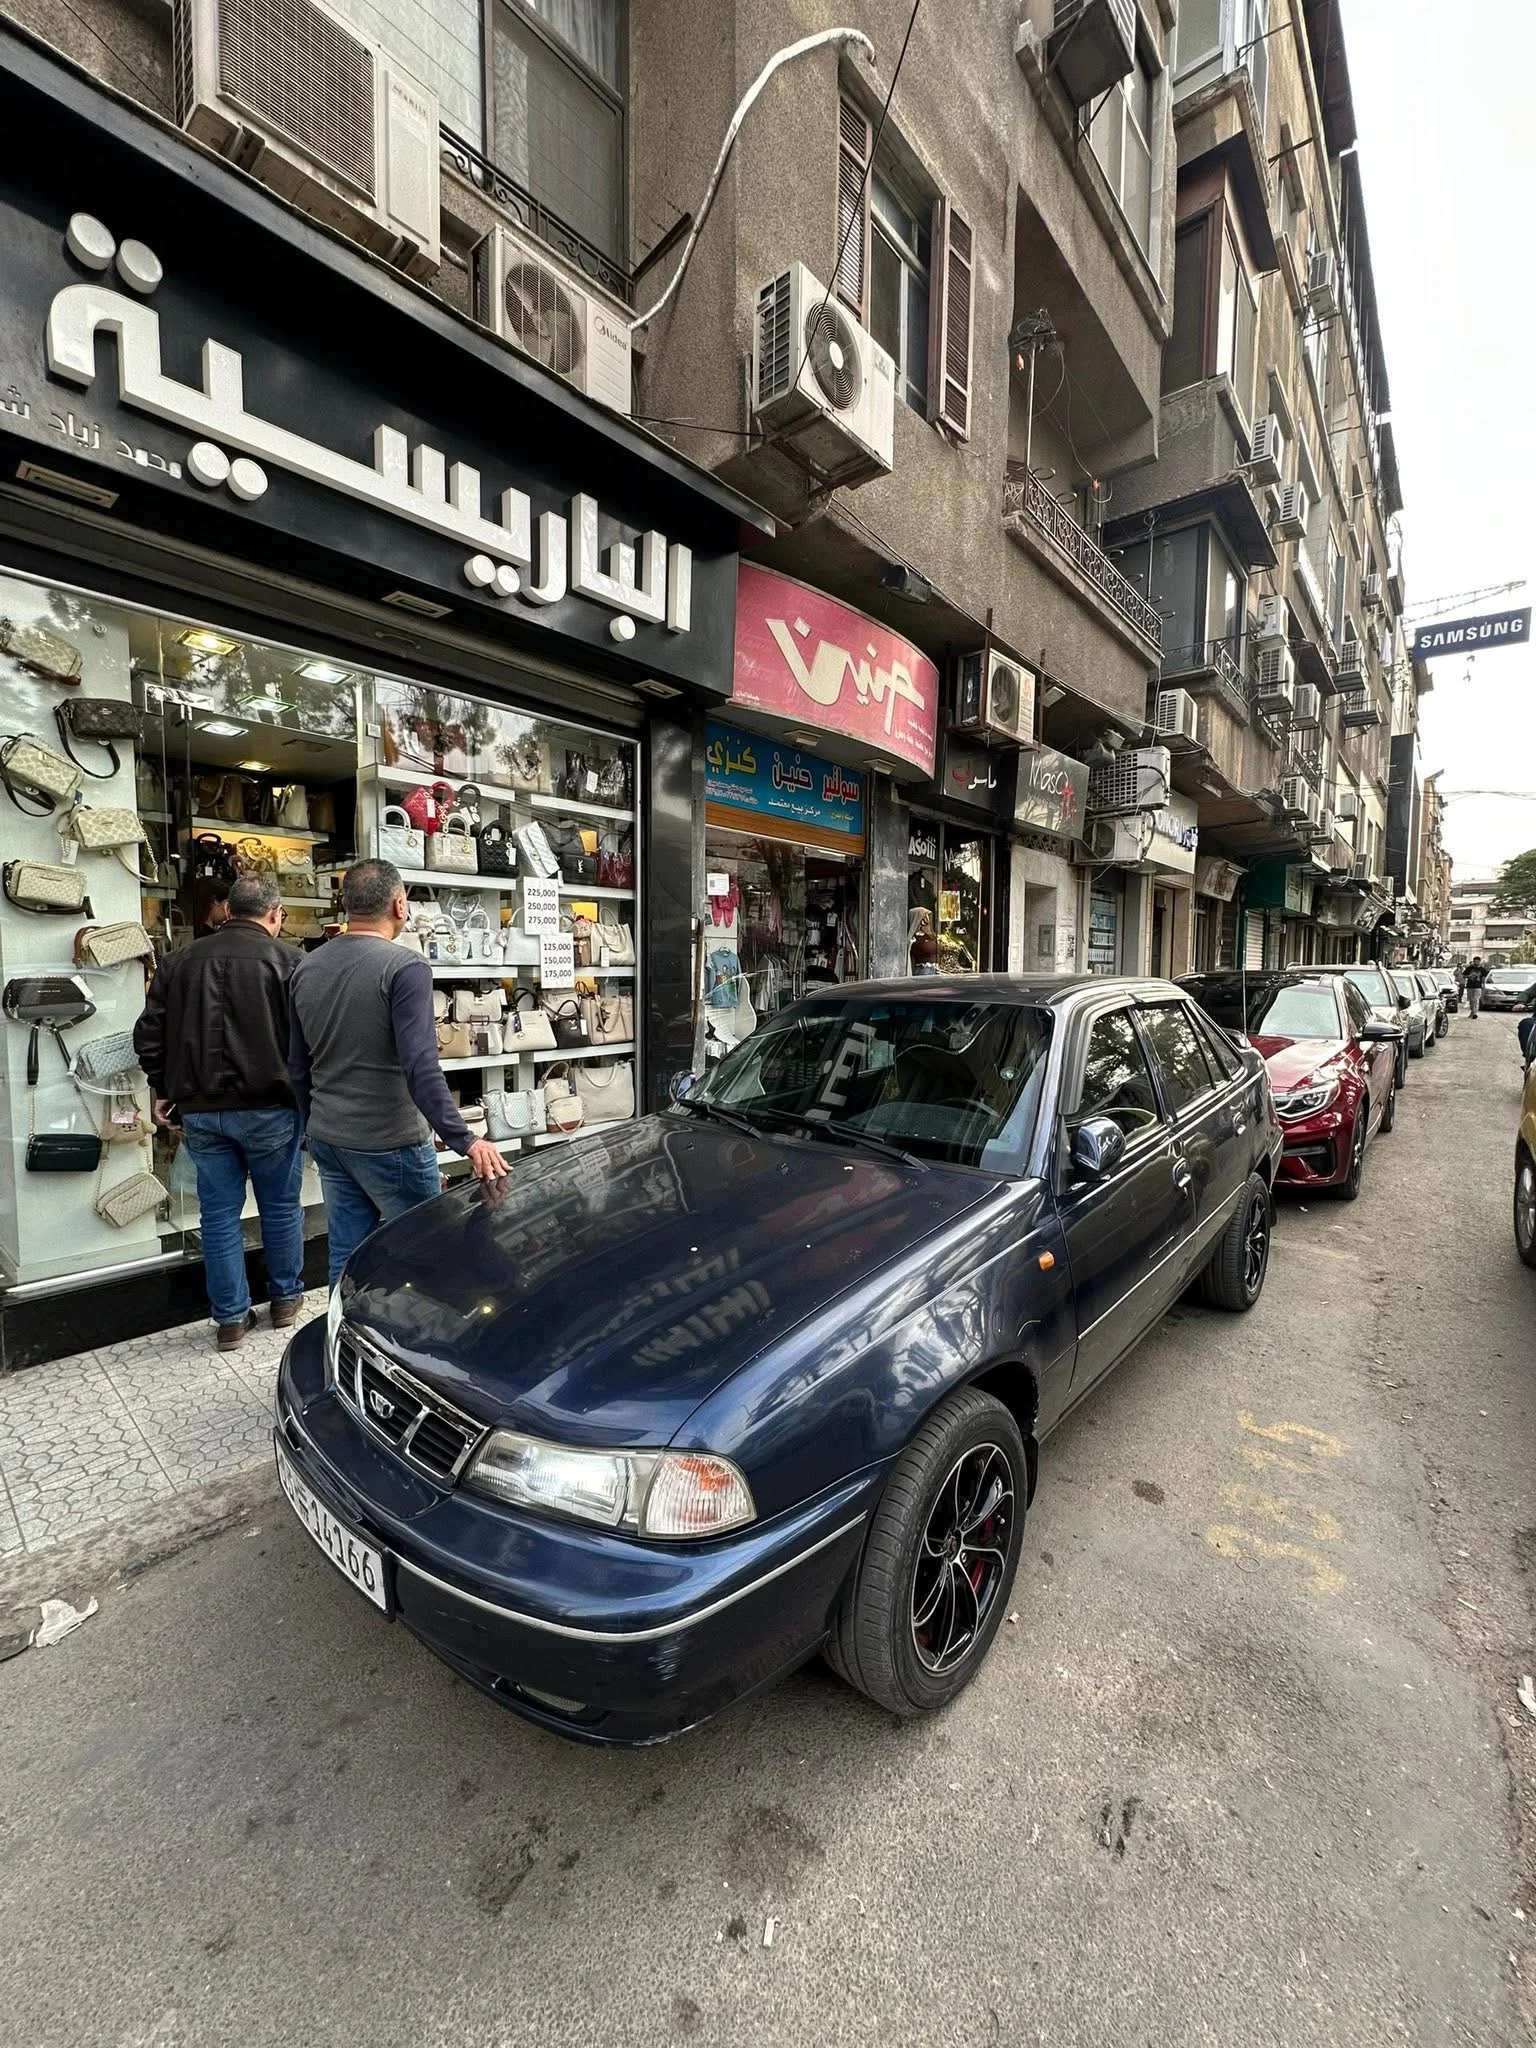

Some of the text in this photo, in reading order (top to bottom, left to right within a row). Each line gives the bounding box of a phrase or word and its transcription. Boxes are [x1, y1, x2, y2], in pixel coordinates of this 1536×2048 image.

[47, 212, 692, 643] الباريسية
[48, 412, 101, 449] زياد
[117, 439, 182, 480] محمد
[1420, 619, 1524, 649] SAMSUNG
[765, 617, 925, 736] حنين
[706, 735, 757, 776] كنزي
[772, 751, 813, 793] حنين
[768, 798, 821, 817] مركز بيع معتمد
[527, 888, 556, 898] 225,000
[527, 902, 557, 912] 250,000
[528, 915, 557, 925] 275,000
[543, 943, 571, 952] 125,000
[544, 956, 572, 965] 150,000
[544, 969, 572, 978] 175,000
[310, 1499, 375, 1593] 14166
